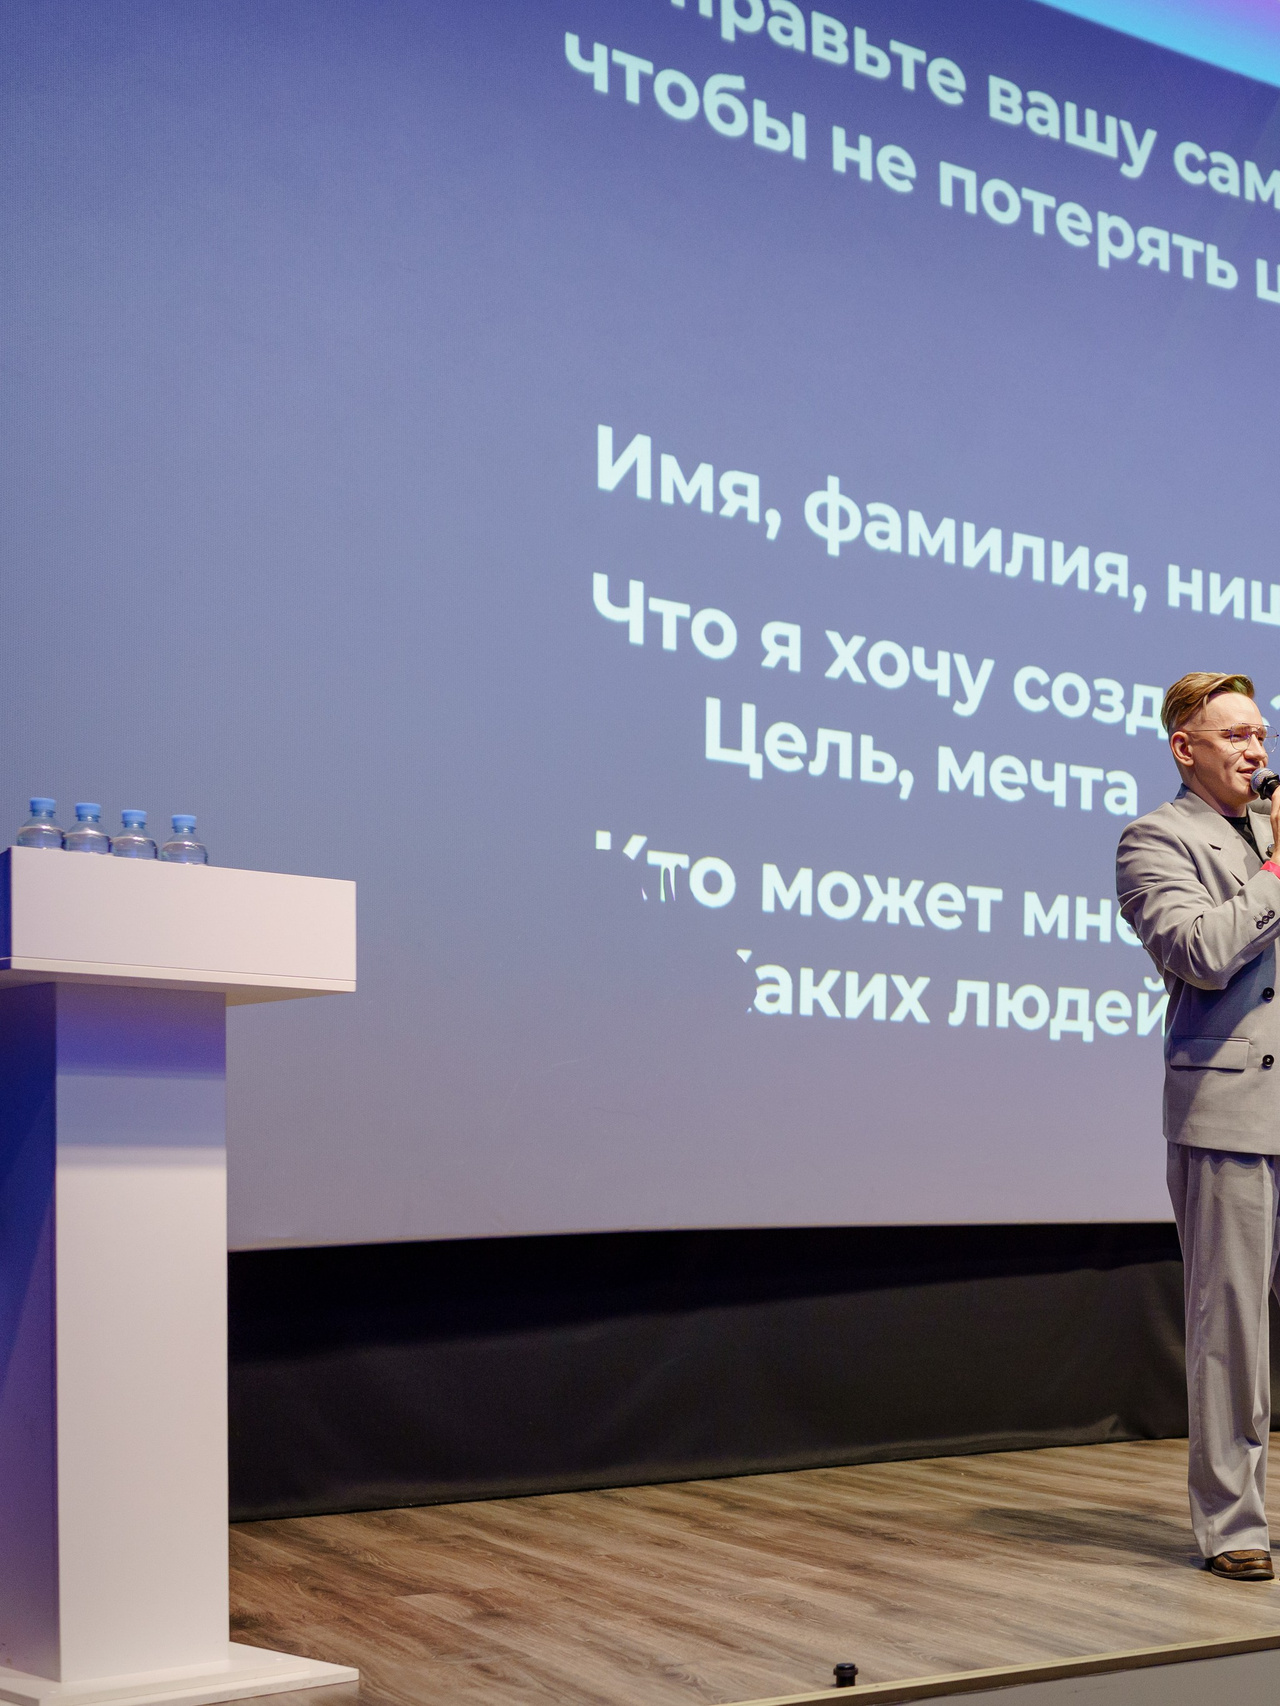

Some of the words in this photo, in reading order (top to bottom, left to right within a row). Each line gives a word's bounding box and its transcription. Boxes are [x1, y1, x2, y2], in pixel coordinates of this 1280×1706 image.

[564, 32, 807, 161] чтобы
[832, 126, 917, 194] не
[939, 161, 1239, 290] потерять
[671, 0, 967, 106] равьте
[988, 74, 1158, 180] вашу
[597, 423, 782, 541] Имя,
[803, 475, 1148, 614] фамилия,
[592, 571, 738, 661] Что
[760, 620, 802, 673] я
[824, 629, 996, 718] хочу
[704, 696, 915, 801] Цель,
[937, 745, 1138, 817] мечта
[761, 862, 1004, 933] может
[736, 948, 931, 1024] аких
